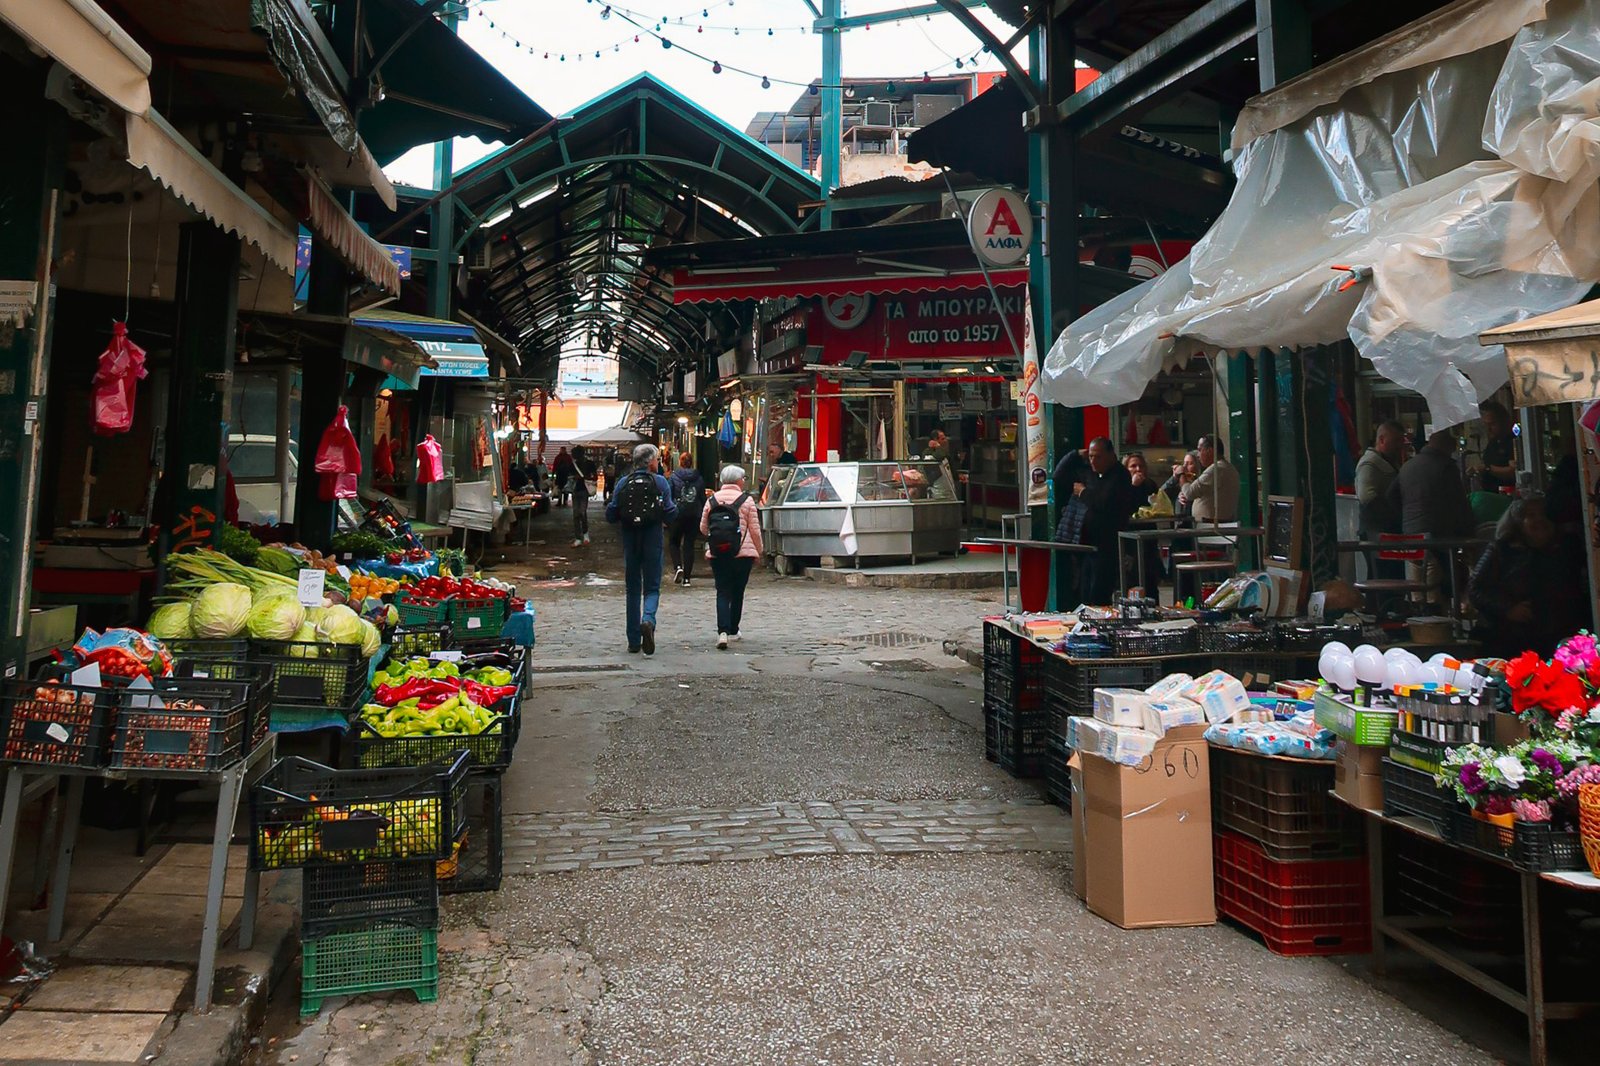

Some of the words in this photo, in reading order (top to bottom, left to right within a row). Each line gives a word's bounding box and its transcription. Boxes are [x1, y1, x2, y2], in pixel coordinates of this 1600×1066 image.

[985, 237, 1022, 249] ΑΛΦΑ
[884, 302, 905, 319] ΤΑ
[908, 329, 939, 344] απο
[942, 329, 960, 343] το
[964, 324, 999, 343] 1957
